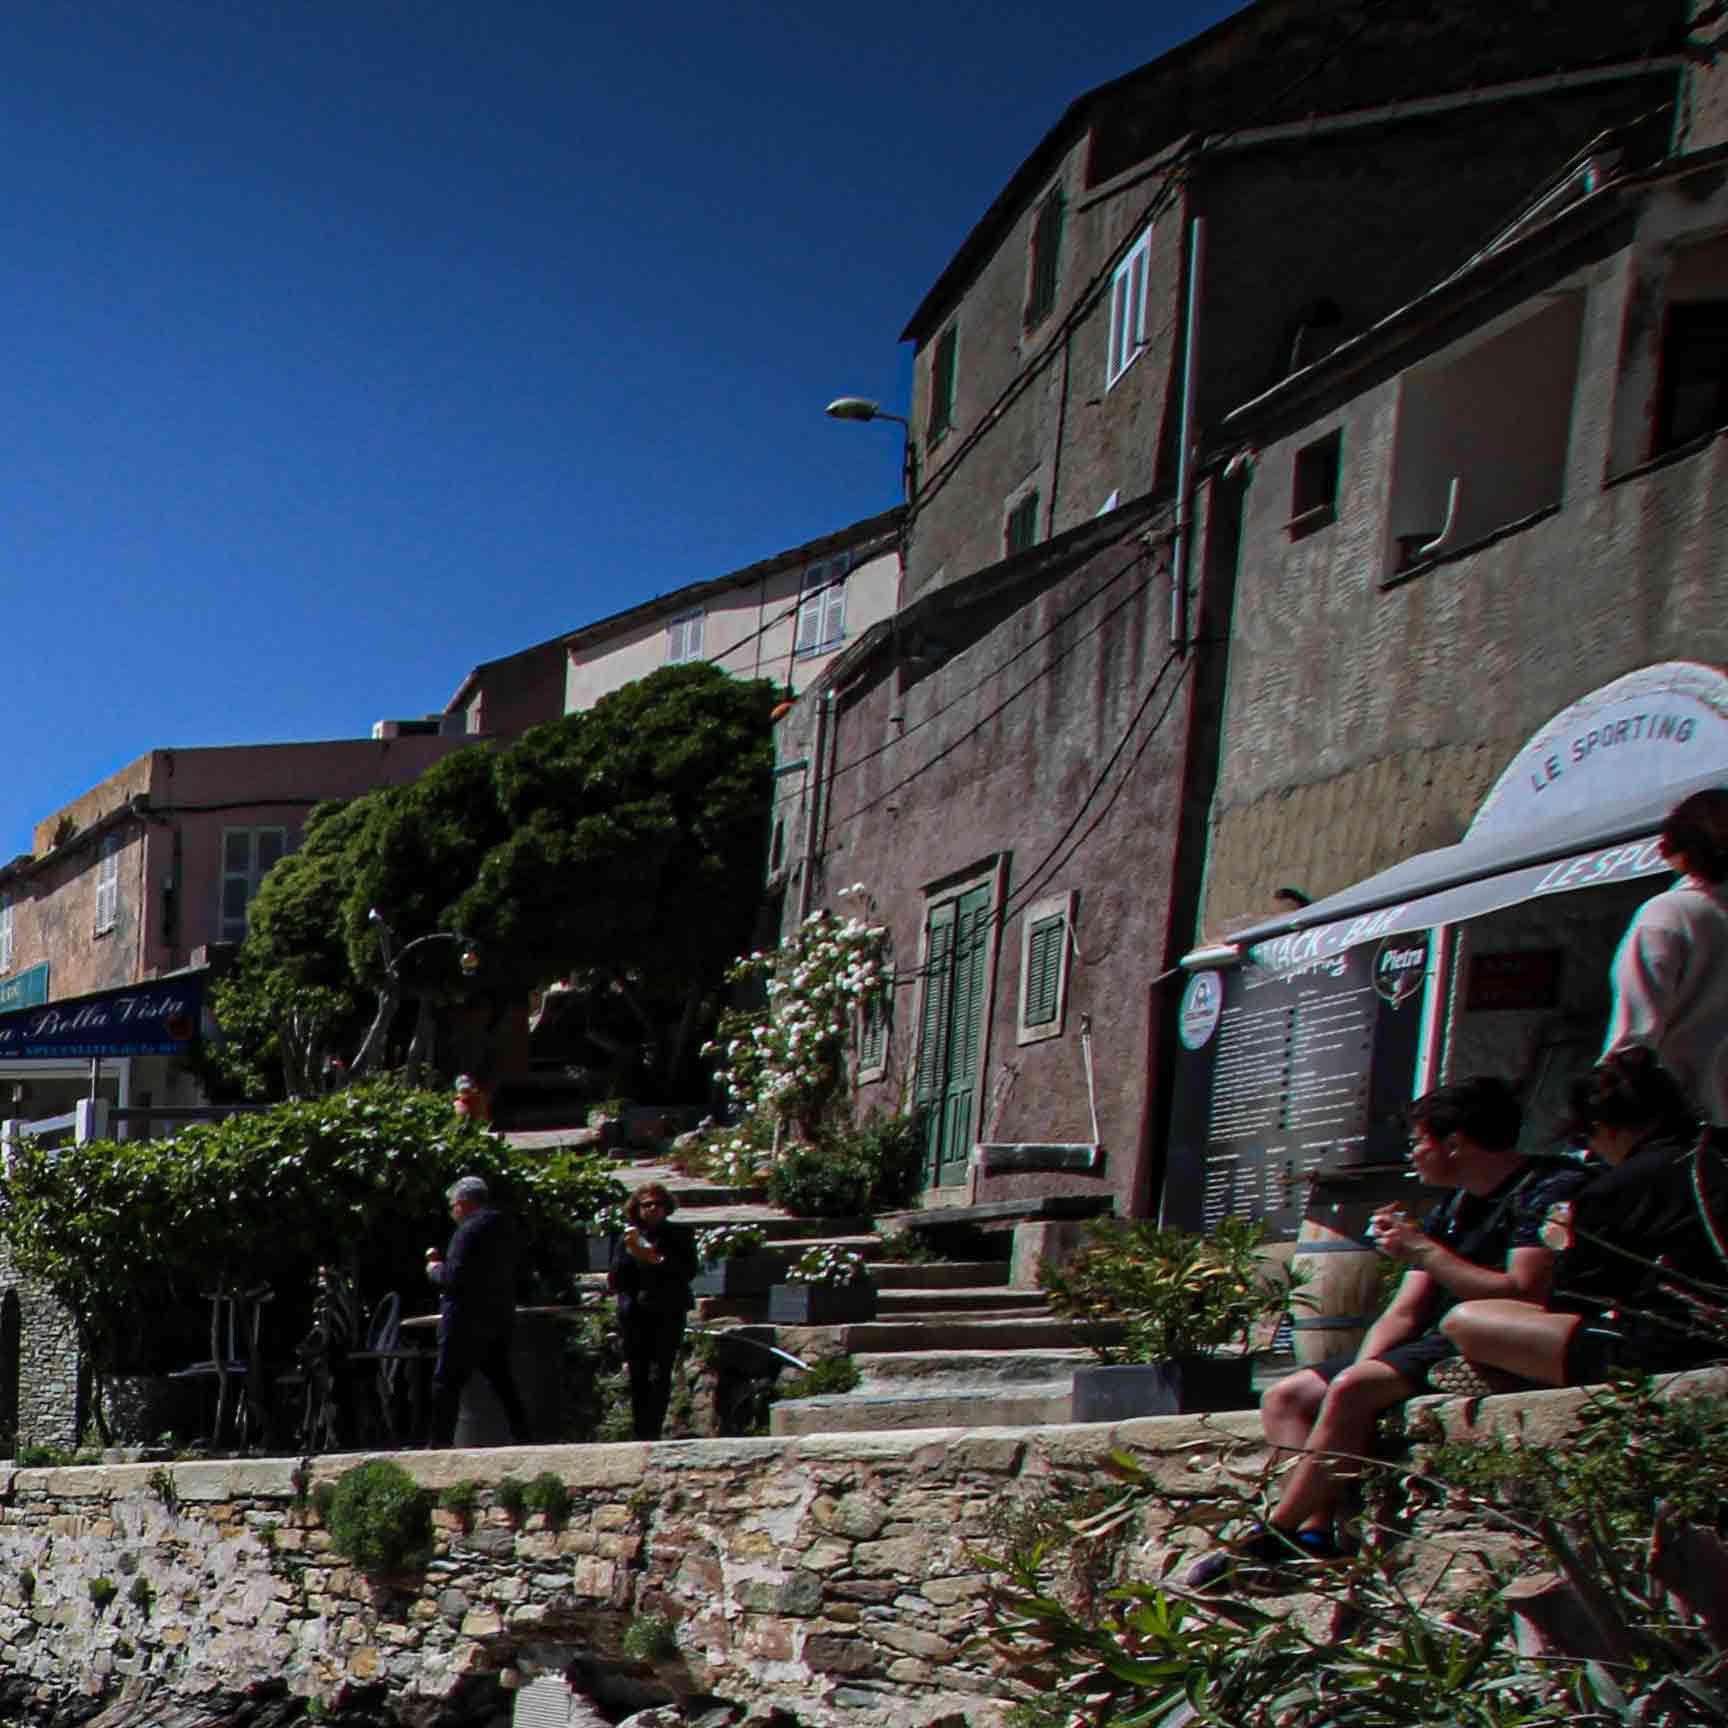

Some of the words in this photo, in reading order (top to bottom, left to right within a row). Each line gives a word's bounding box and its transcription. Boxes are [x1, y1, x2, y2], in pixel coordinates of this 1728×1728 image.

[1531, 754, 1562, 792] LE
[1571, 714, 1697, 763] SPORTING
[22, 1004, 110, 1039] Bella
[114, 993, 185, 1022] Vista
